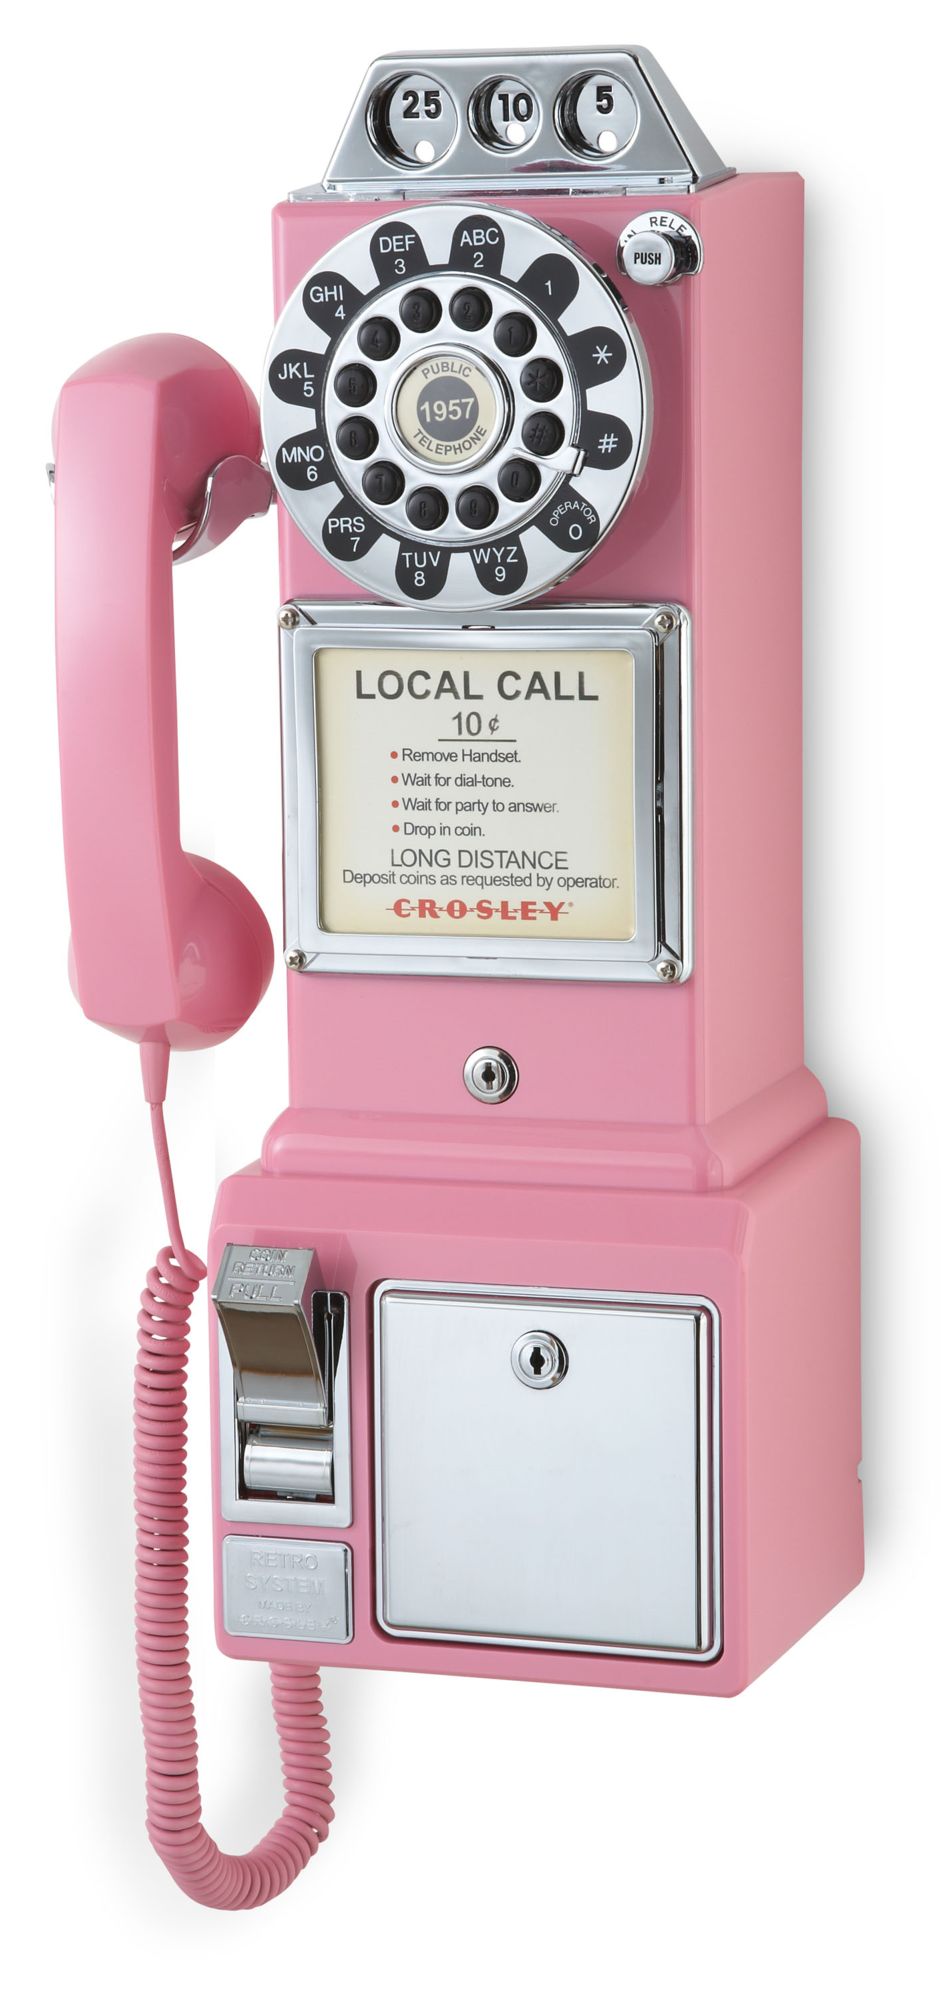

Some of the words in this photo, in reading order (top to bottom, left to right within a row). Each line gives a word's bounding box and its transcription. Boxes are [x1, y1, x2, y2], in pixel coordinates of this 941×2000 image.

[402, 89, 443, 120] 25
[498, 92, 534, 122] 10
[595, 85, 615, 115] 5
[460, 227, 500, 247] ABC
[649, 216, 692, 240] RELE
[379, 234, 416, 253] DEF
[394, 258, 406, 275] 3
[473, 252, 485, 268] 2
[633, 252, 662, 265] PUSH
[309, 284, 344, 303] GHI
[544, 279, 552, 296] 1
[334, 305, 346, 320] 4
[278, 362, 315, 380] JKL
[421, 361, 473, 380] PUBLIC
[303, 381, 315, 398] 5
[420, 397, 475, 423] 1957
[413, 425, 488, 456] TELEPHONE
[282, 445, 325, 464] MNO
[306, 466, 318, 482] 6
[549, 500, 597, 528] OPERATOR
[328, 516, 366, 535] PRS
[350, 537, 361, 553] 7
[401, 551, 441, 569] TUV
[472, 546, 519, 565] WYZ
[414, 571, 426, 587] 8
[494, 566, 507, 582] 9
[355, 669, 485, 700] LOCAL
[497, 670, 599, 702] CALL
[452, 711, 482, 736] 10
[402, 748, 458, 763] Remove
[462, 749, 522, 763] Handset.
[402, 773, 432, 787] Wait
[434, 773, 452, 787] for
[454, 774, 515, 788] dial-tone.
[402, 797, 432, 812] Wait
[435, 797, 452, 812] for
[455, 799, 489, 816] party
[492, 800, 505, 813] to
[508, 801, 560, 813] answer.
[403, 822, 437, 840] Drop
[440, 823, 451, 836] in
[454, 823, 486, 837] coin.
[391, 848, 452, 868] LONG
[458, 849, 569, 871] DISTANCE
[343, 869, 397, 888] Deposit
[399, 871, 437, 886] coins
[440, 874, 458, 886] as
[461, 872, 532, 890] requested
[536, 873, 554, 891] by
[557, 875, 620, 892] operator.
[393, 898, 567, 921] CROSLEY
[232, 1261, 296, 1278] RETURN
[229, 1282, 283, 1301] PULL
[249, 1551, 319, 1570] RETRO
